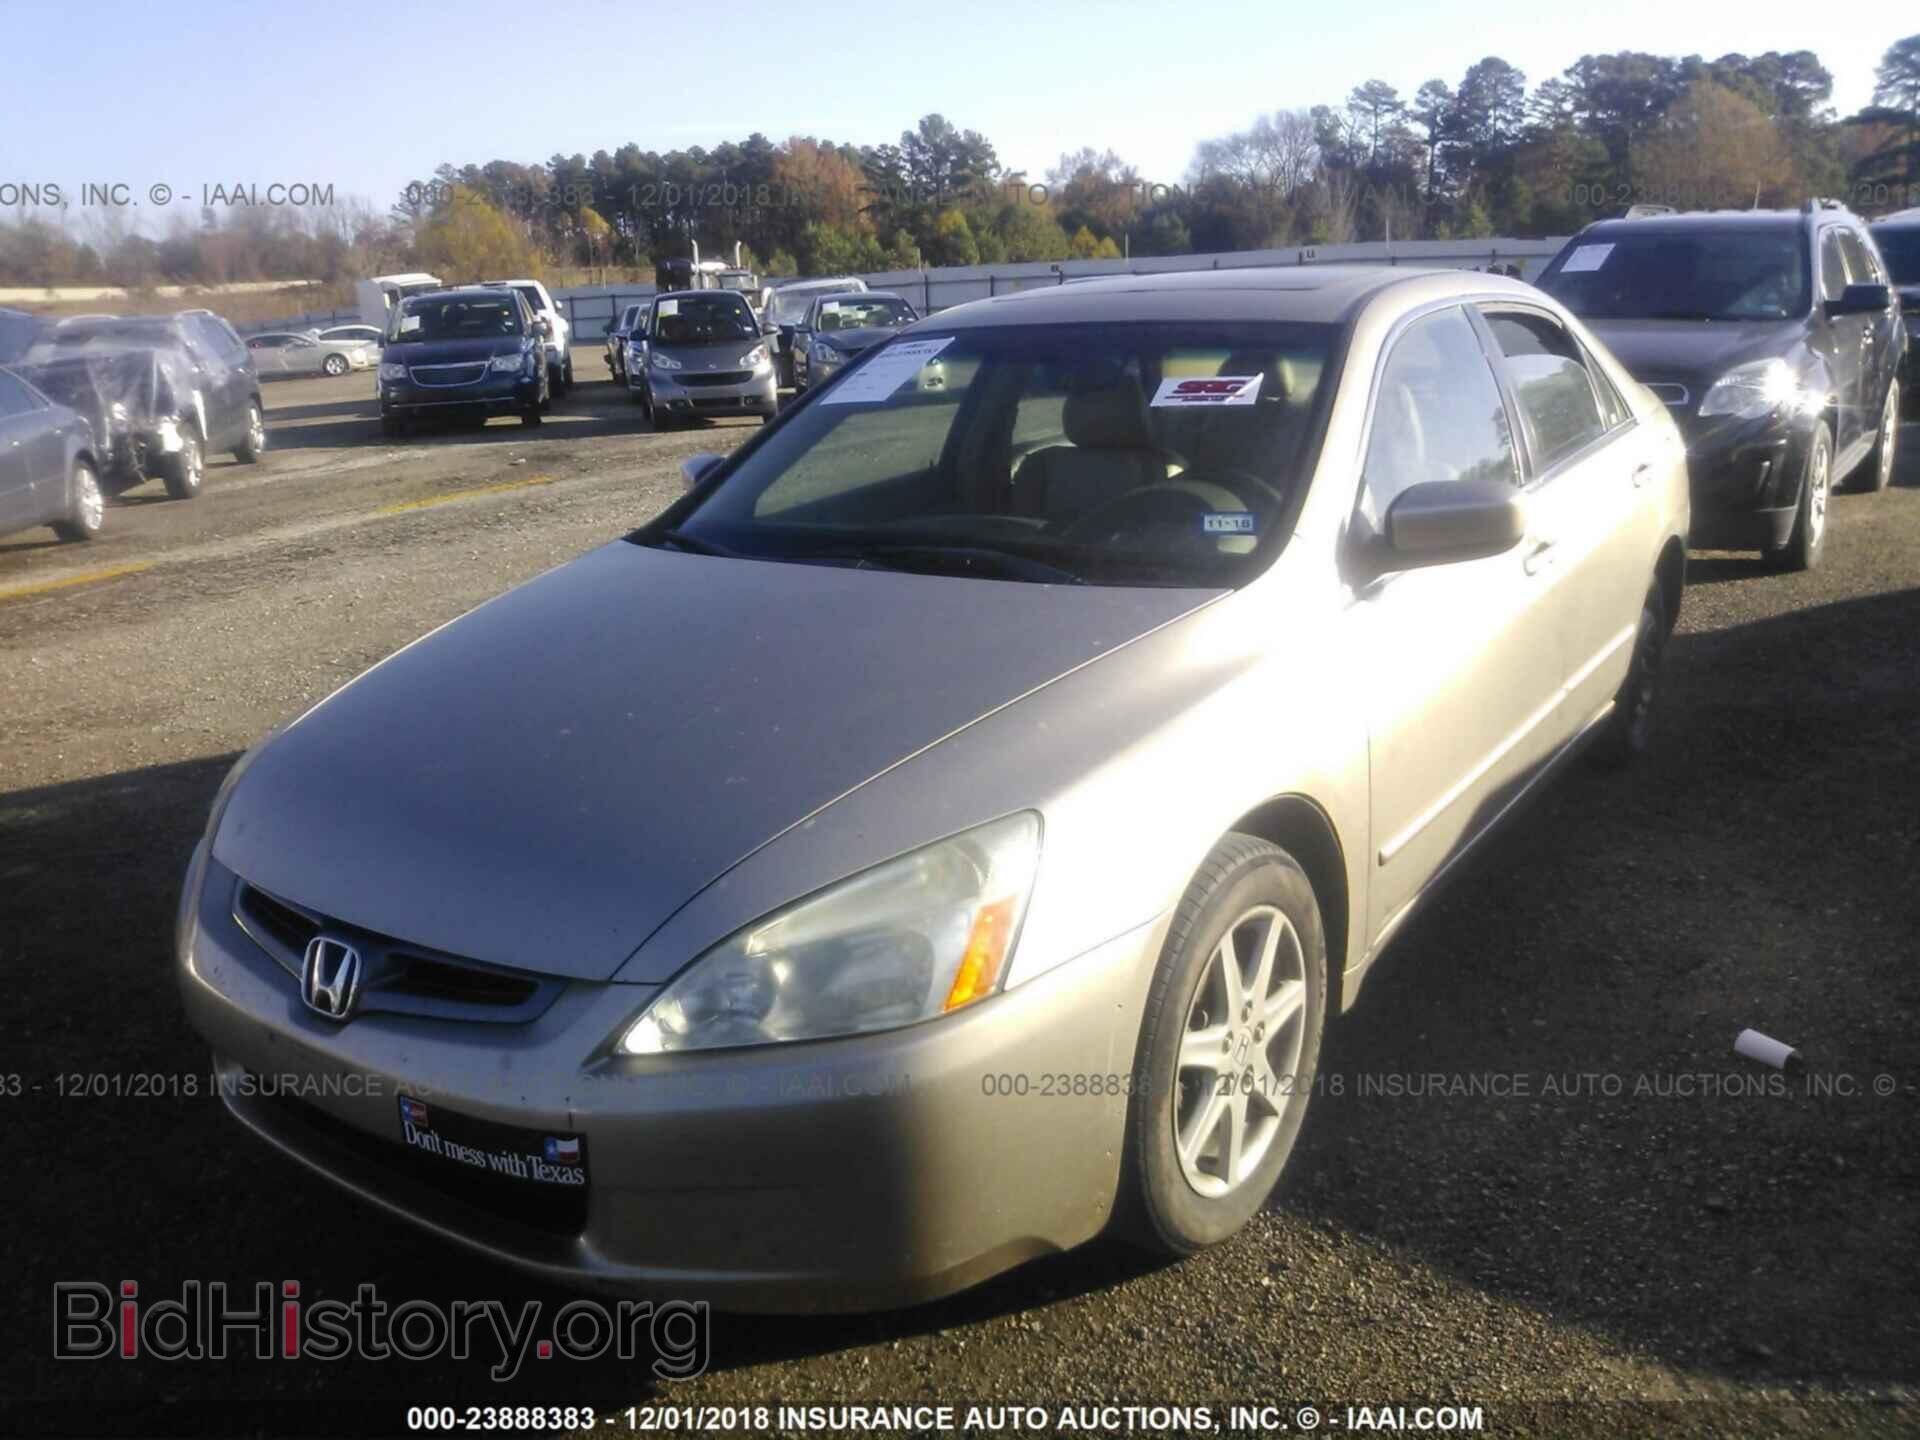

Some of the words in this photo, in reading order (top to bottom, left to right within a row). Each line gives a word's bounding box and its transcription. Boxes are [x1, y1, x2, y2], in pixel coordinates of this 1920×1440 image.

[404, 1121, 442, 1154] Don't
[444, 1140, 486, 1168] mess
[488, 1151, 527, 1178] with
[527, 1155, 585, 1185] Texas
